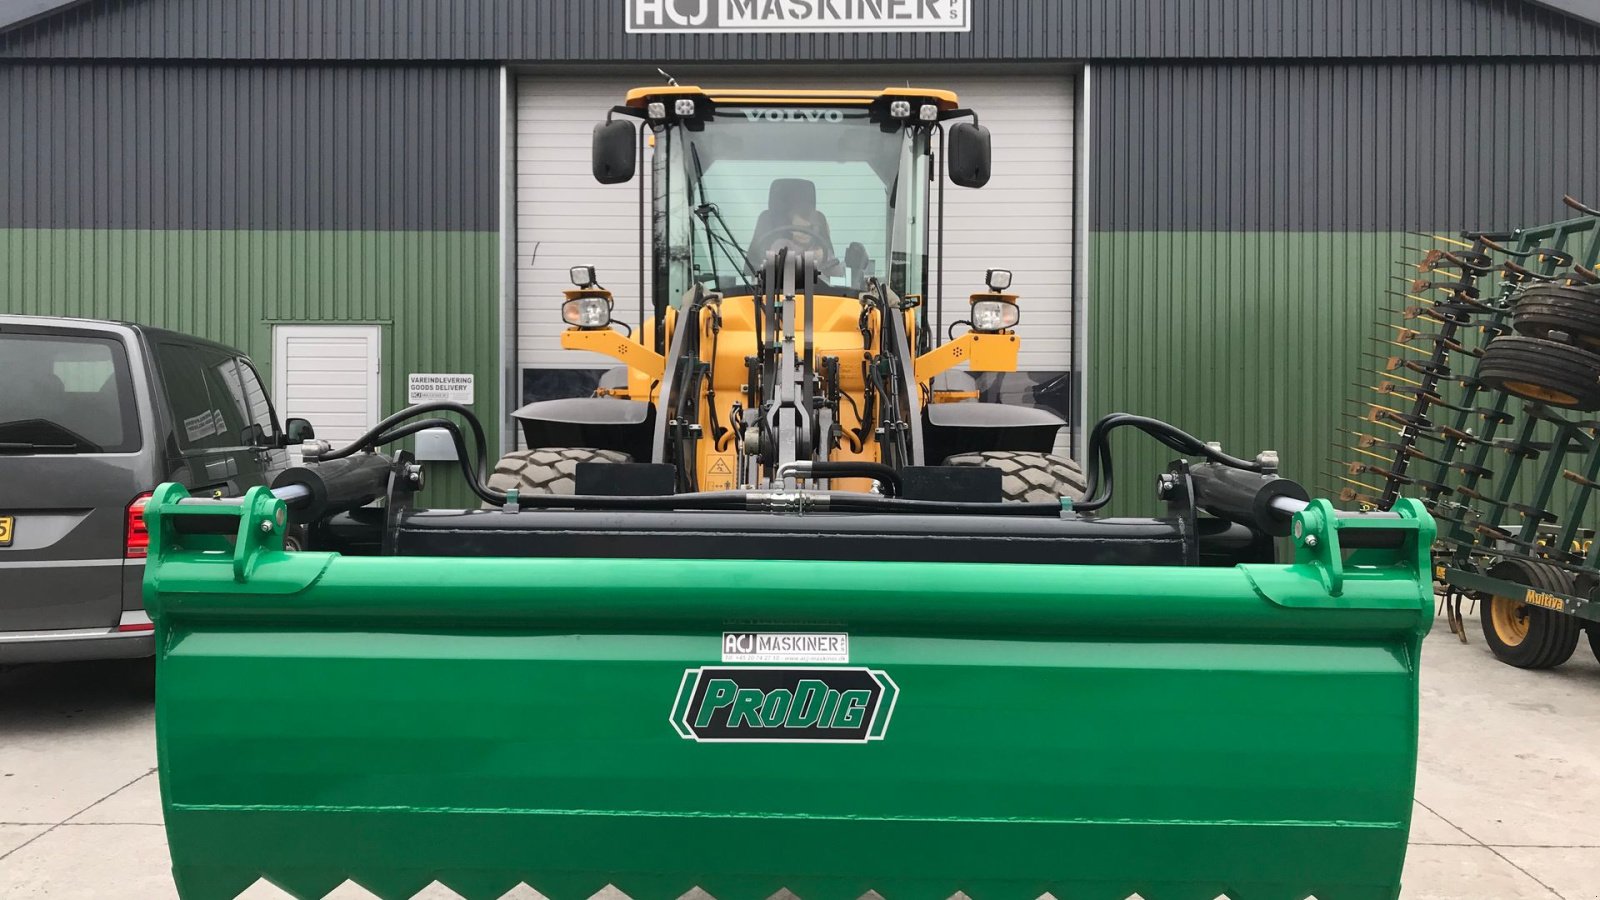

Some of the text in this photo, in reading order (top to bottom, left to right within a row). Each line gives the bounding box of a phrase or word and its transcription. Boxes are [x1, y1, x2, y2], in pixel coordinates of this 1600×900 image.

[740, 109, 844, 123] VOLVO
[1525, 588, 1565, 612] Multiva
[725, 634, 753, 653] ACJ
[759, 636, 838, 651] MASKINER
